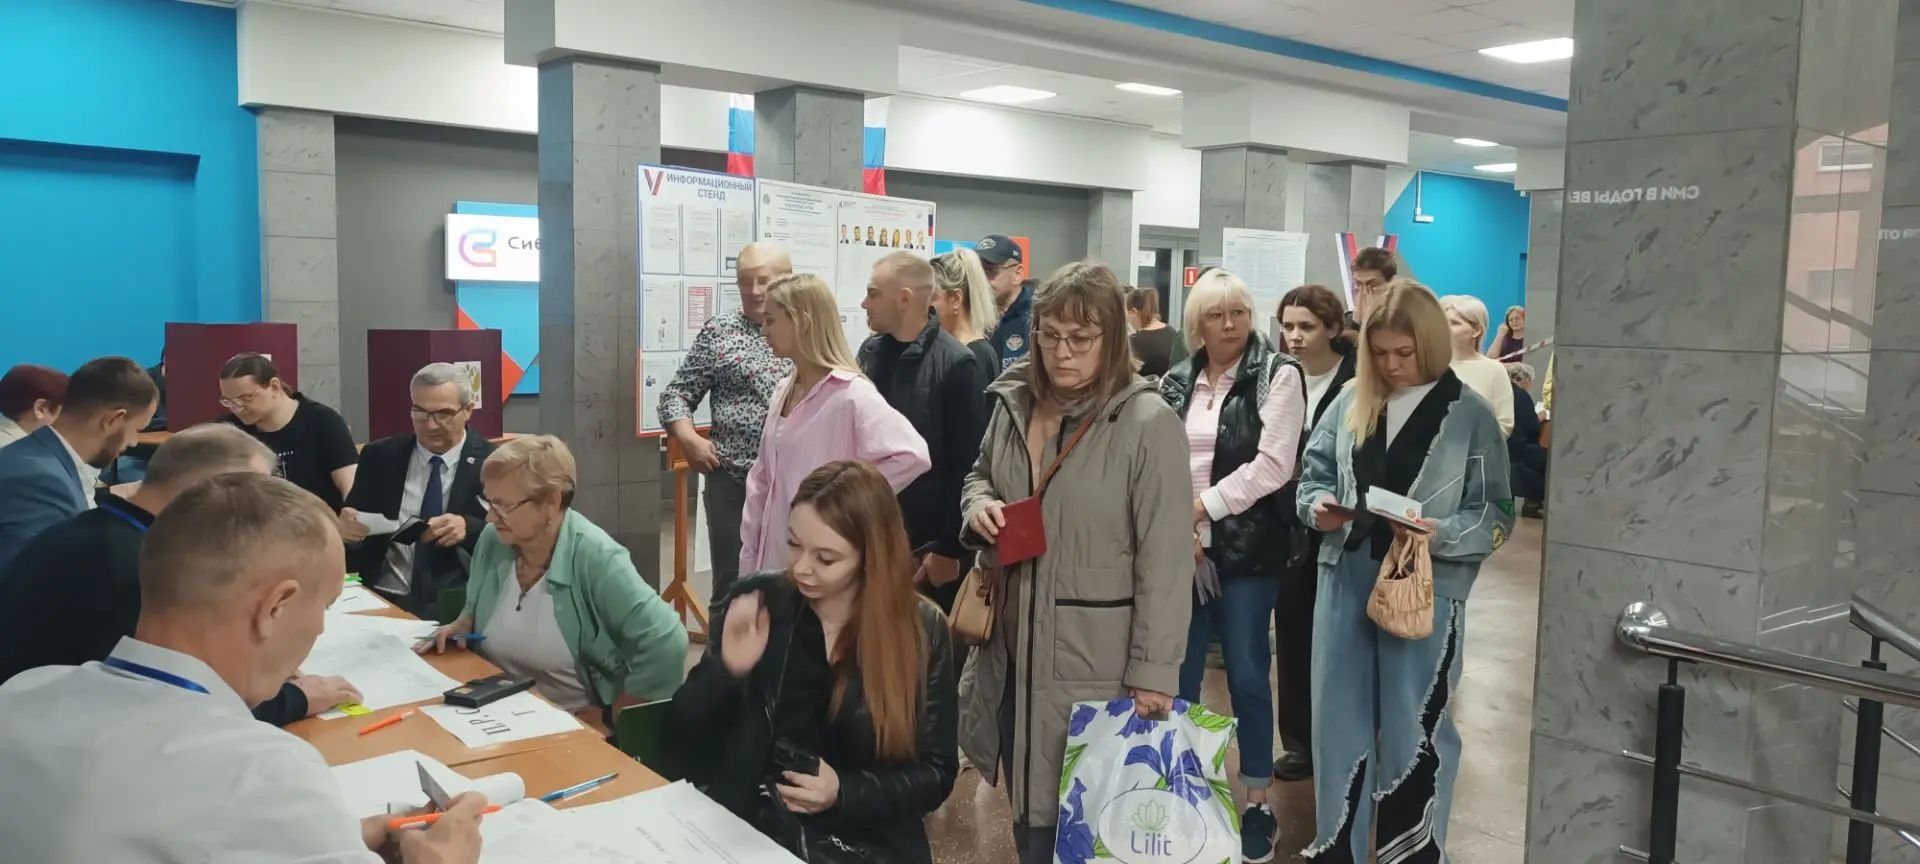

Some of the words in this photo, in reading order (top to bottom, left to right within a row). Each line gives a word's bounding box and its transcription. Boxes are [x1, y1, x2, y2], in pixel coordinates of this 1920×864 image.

[666, 173, 752, 191] ИНФОРМАЦИОННЫЙ
[697, 188, 726, 201] СТЕНД
[1130, 830, 1172, 857] Lilit
